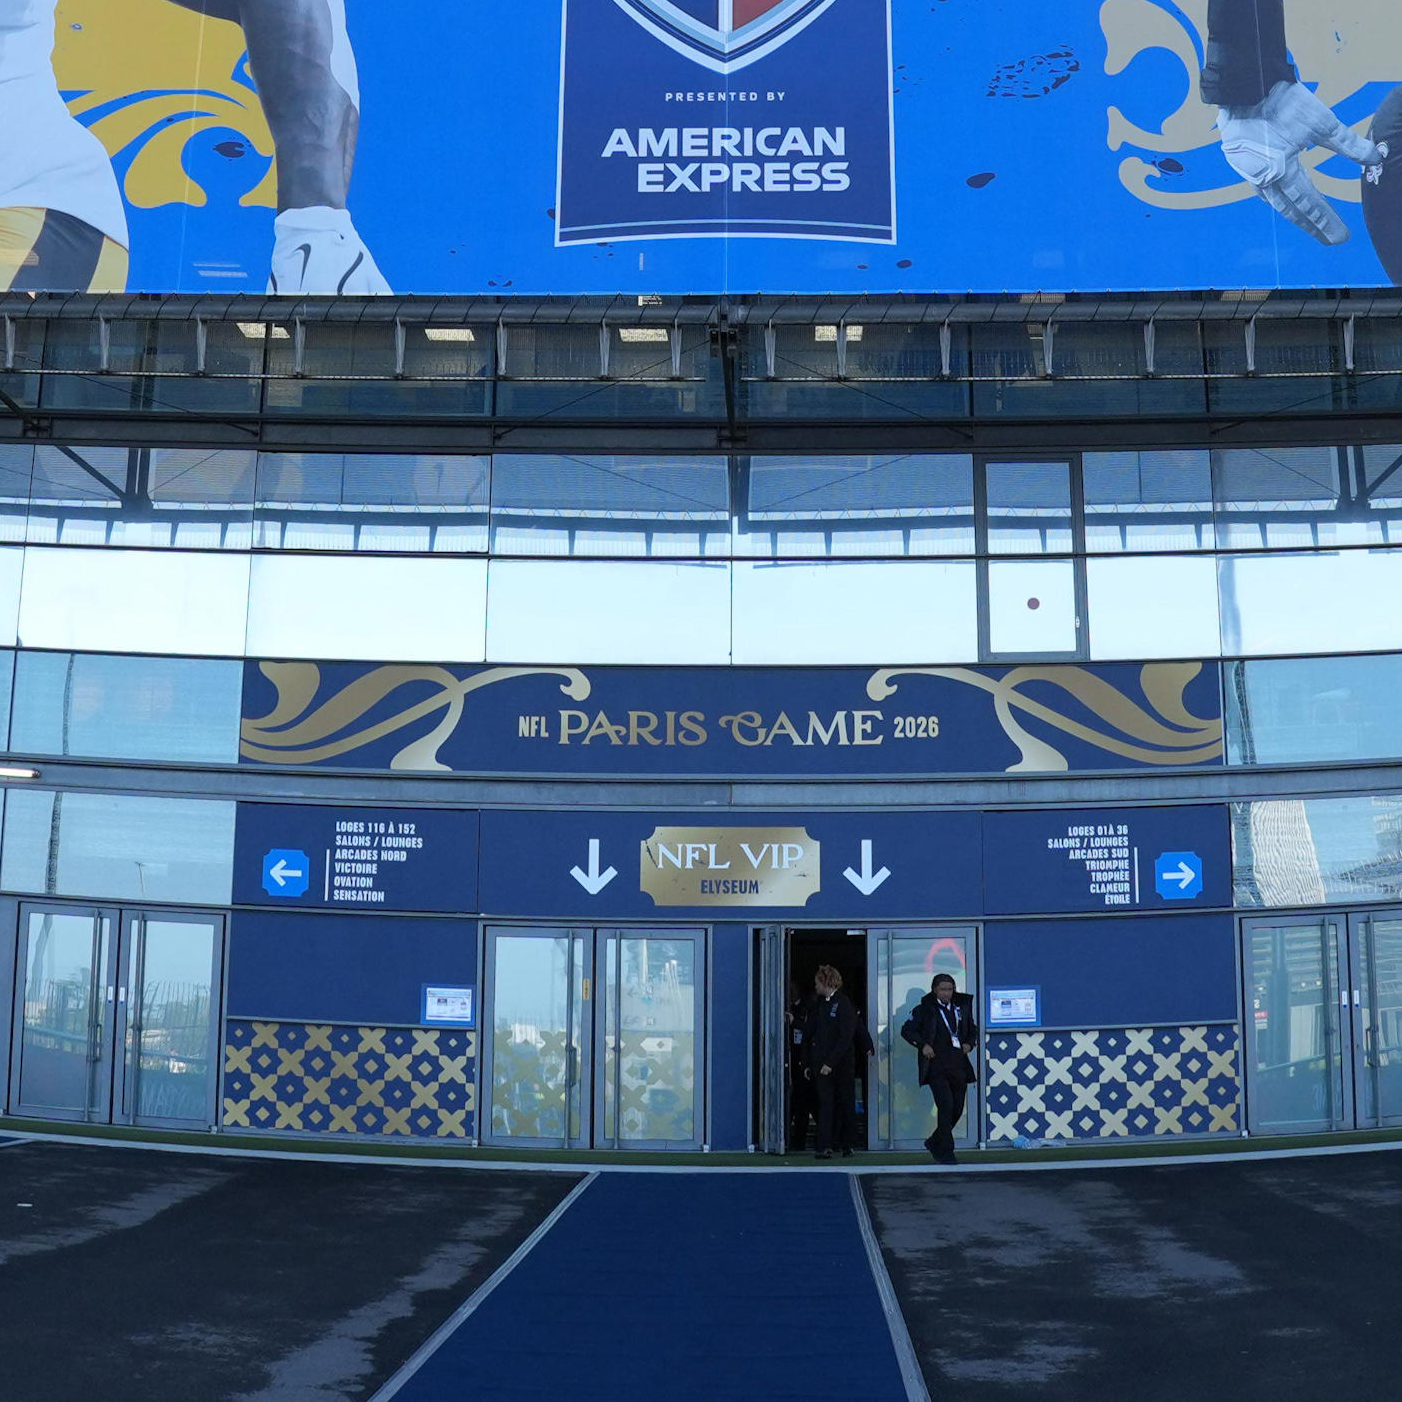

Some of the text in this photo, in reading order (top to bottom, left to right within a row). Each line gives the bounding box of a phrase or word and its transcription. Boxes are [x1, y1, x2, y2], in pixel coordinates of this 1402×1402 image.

[665, 91, 786, 102] PRESENTED BY
[601, 126, 846, 158] AMERICAN
[637, 162, 850, 192] EXPRESS
[519, 710, 940, 746] NFL PARIS GAME 2026
[336, 821, 365, 833] LOGES
[398, 823, 416, 834] 152
[1068, 825, 1095, 837] LOGES
[1116, 825, 1129, 835] 36
[335, 834, 371, 847] SALONS
[381, 836, 423, 848] LOUNGES
[1047, 838, 1080, 849] SALONS
[1090, 836, 1128, 847] LOUNGES
[335, 848, 407, 861] ARCADES NORD
[655, 842, 804, 870] NFL VIP
[1068, 848, 1129, 860] ARCADES SUD
[334, 862, 378, 874] VICTOIRE
[1085, 859, 1129, 870] TRIOMPHE
[334, 875, 373, 888] OVATION
[700, 878, 759, 895] ELYSEUM
[1090, 882, 1130, 894] CLAMEUR
[333, 889, 385, 902] SENSATION
